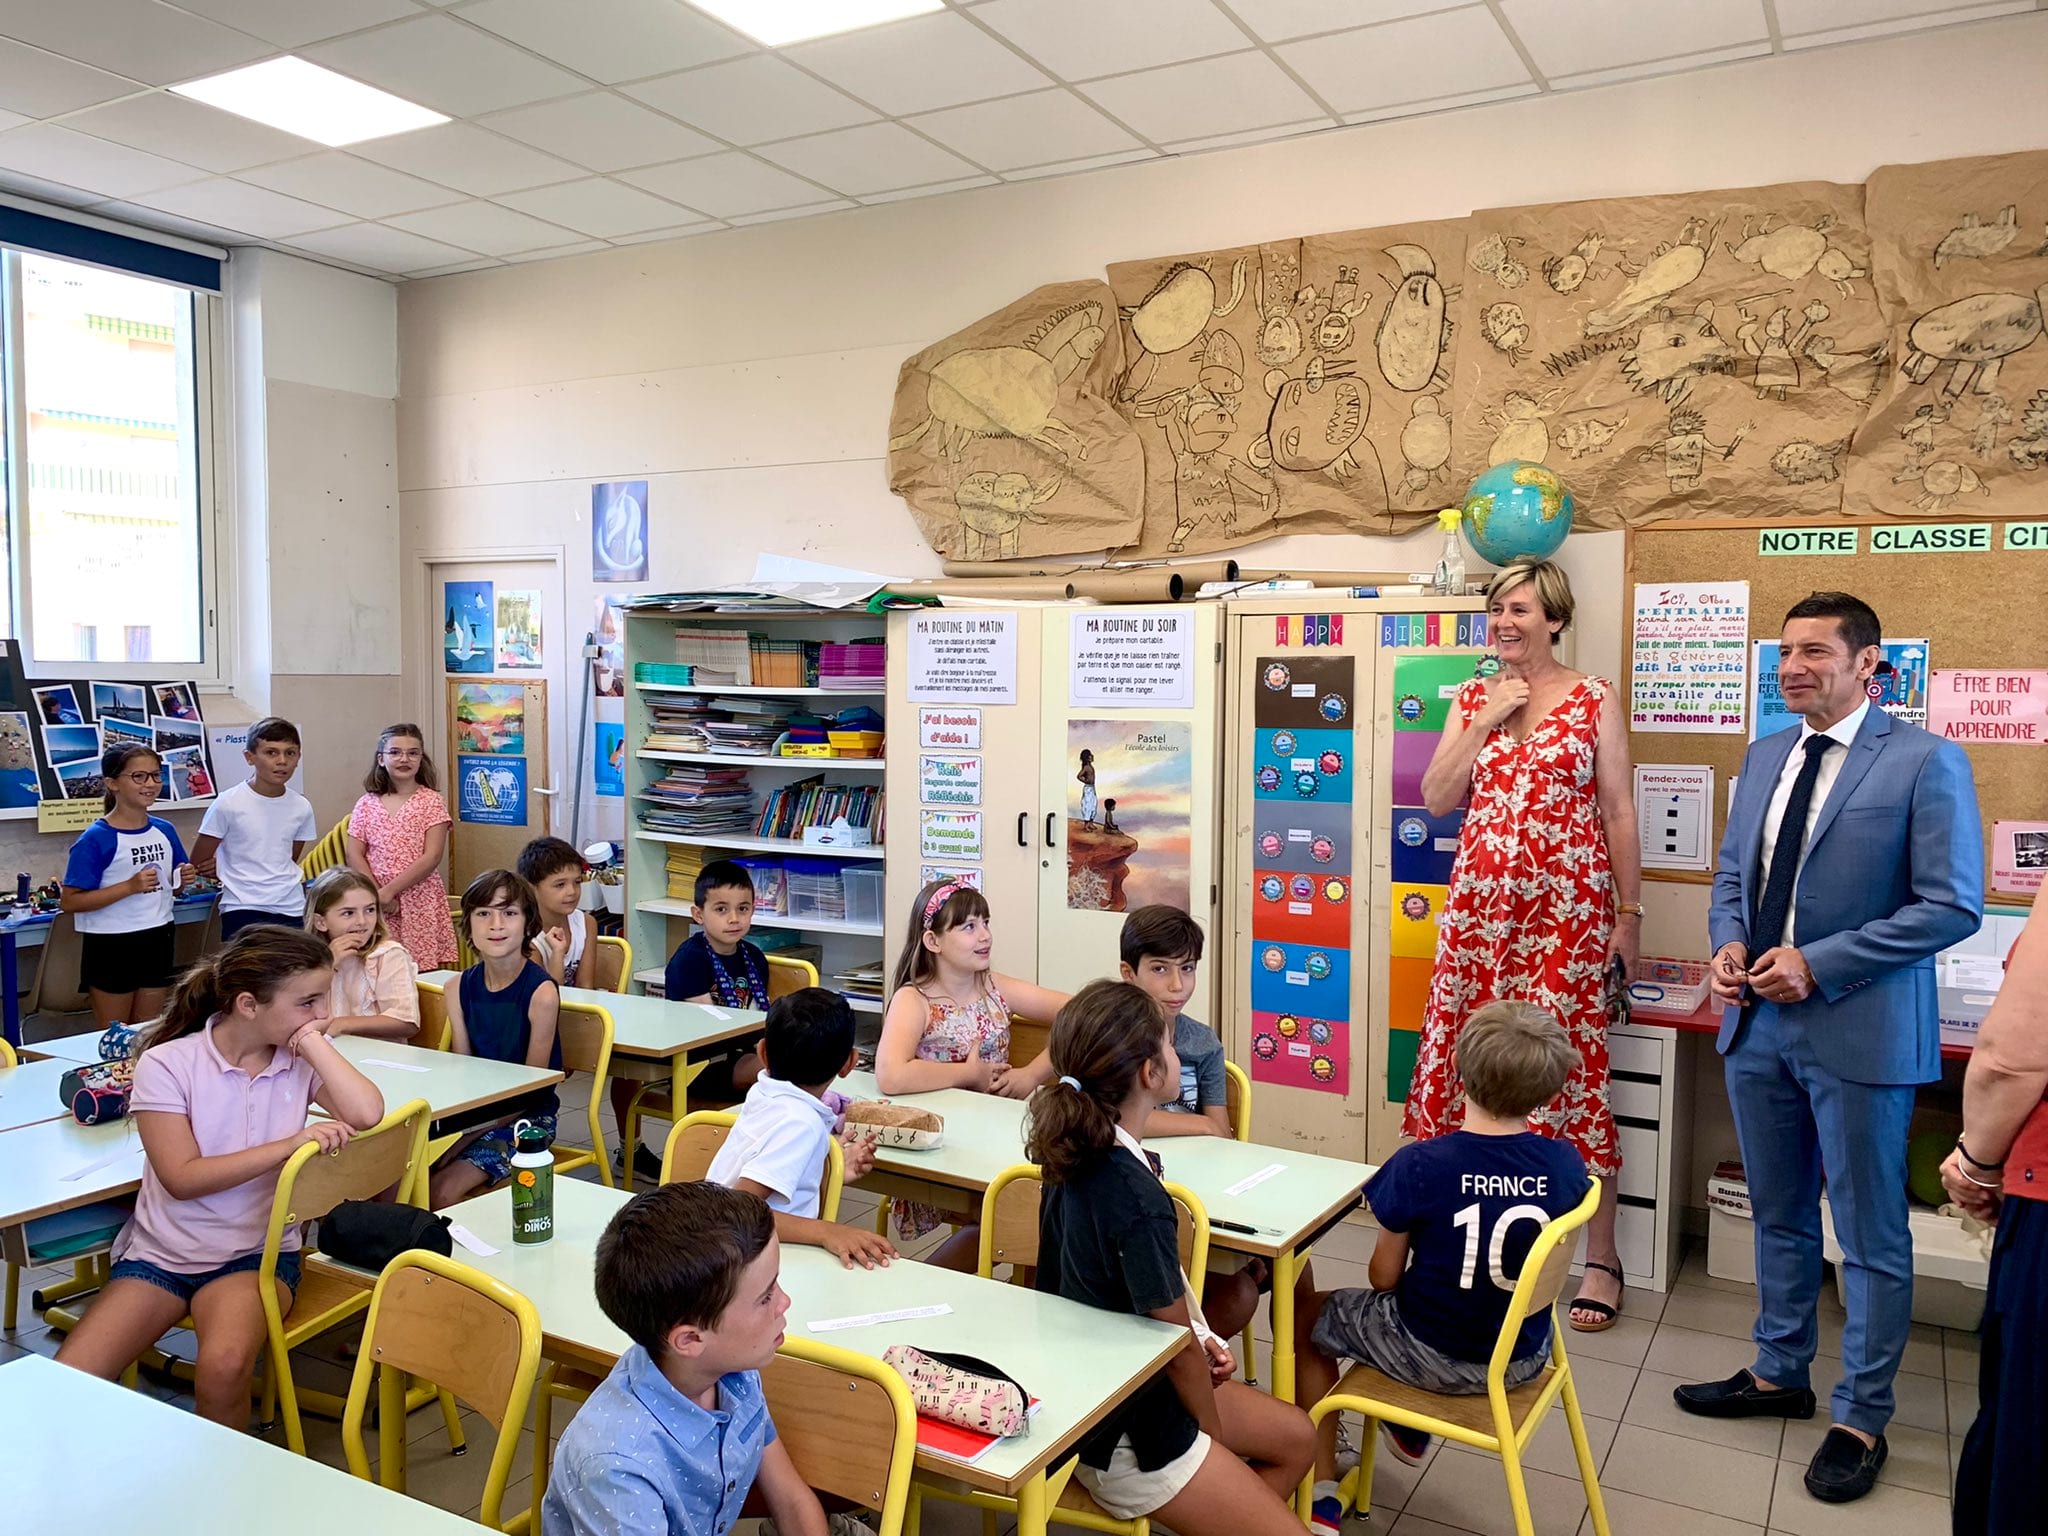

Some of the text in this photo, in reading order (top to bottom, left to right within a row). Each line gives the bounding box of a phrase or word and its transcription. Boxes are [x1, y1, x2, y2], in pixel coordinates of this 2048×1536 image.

[1762, 531, 1854, 551] NOTRE
[1873, 528, 1986, 549] CLASSE
[1638, 607, 1744, 616] S'ENTRAIDE
[1086, 619, 1177, 632] MA ROUTINE DU SOIR
[1636, 612, 1669, 626] prend
[1702, 613, 1714, 622] de
[917, 620, 1004, 634] MA ROUTINE DU MATIN
[1278, 624, 1485, 641] HAPPY BIRTHDA
[1636, 640, 1649, 648] Fait
[1652, 640, 1660, 648] de
[1663, 640, 1683, 648] notre
[1712, 640, 1744, 650] Toujours
[1635, 662, 1743, 672] dit la vérité
[1954, 673, 2031, 693] ÊTRE BIEN
[1634, 690, 1742, 699] travaille dur
[1633, 700, 1742, 713] joue fair play
[1970, 700, 2012, 716] POUR
[923, 714, 977, 726] J'ai besoin
[1653, 713, 1714, 723] ronchonne
[1721, 714, 1741, 725] pas
[1885, 710, 1925, 718] sandre
[1944, 722, 2037, 739] APPRENDRE
[225, 735, 246, 743] Plast
[930, 732, 968, 744] d'aide !
[1137, 734, 1166, 743] Pastel
[938, 766, 962, 776] Relis
[1643, 775, 1703, 783] Rendez-vous
[928, 790, 973, 802] Réfléchis
[927, 826, 975, 839] Demande
[131, 843, 164, 856] DEVIL
[132, 852, 165, 865] FRUIT
[1461, 1174, 1548, 1197] FRANCE
[1718, 1187, 1750, 1199] Busine
[524, 1218, 551, 1232] DINOS
[1453, 1202, 1551, 1292] 10
